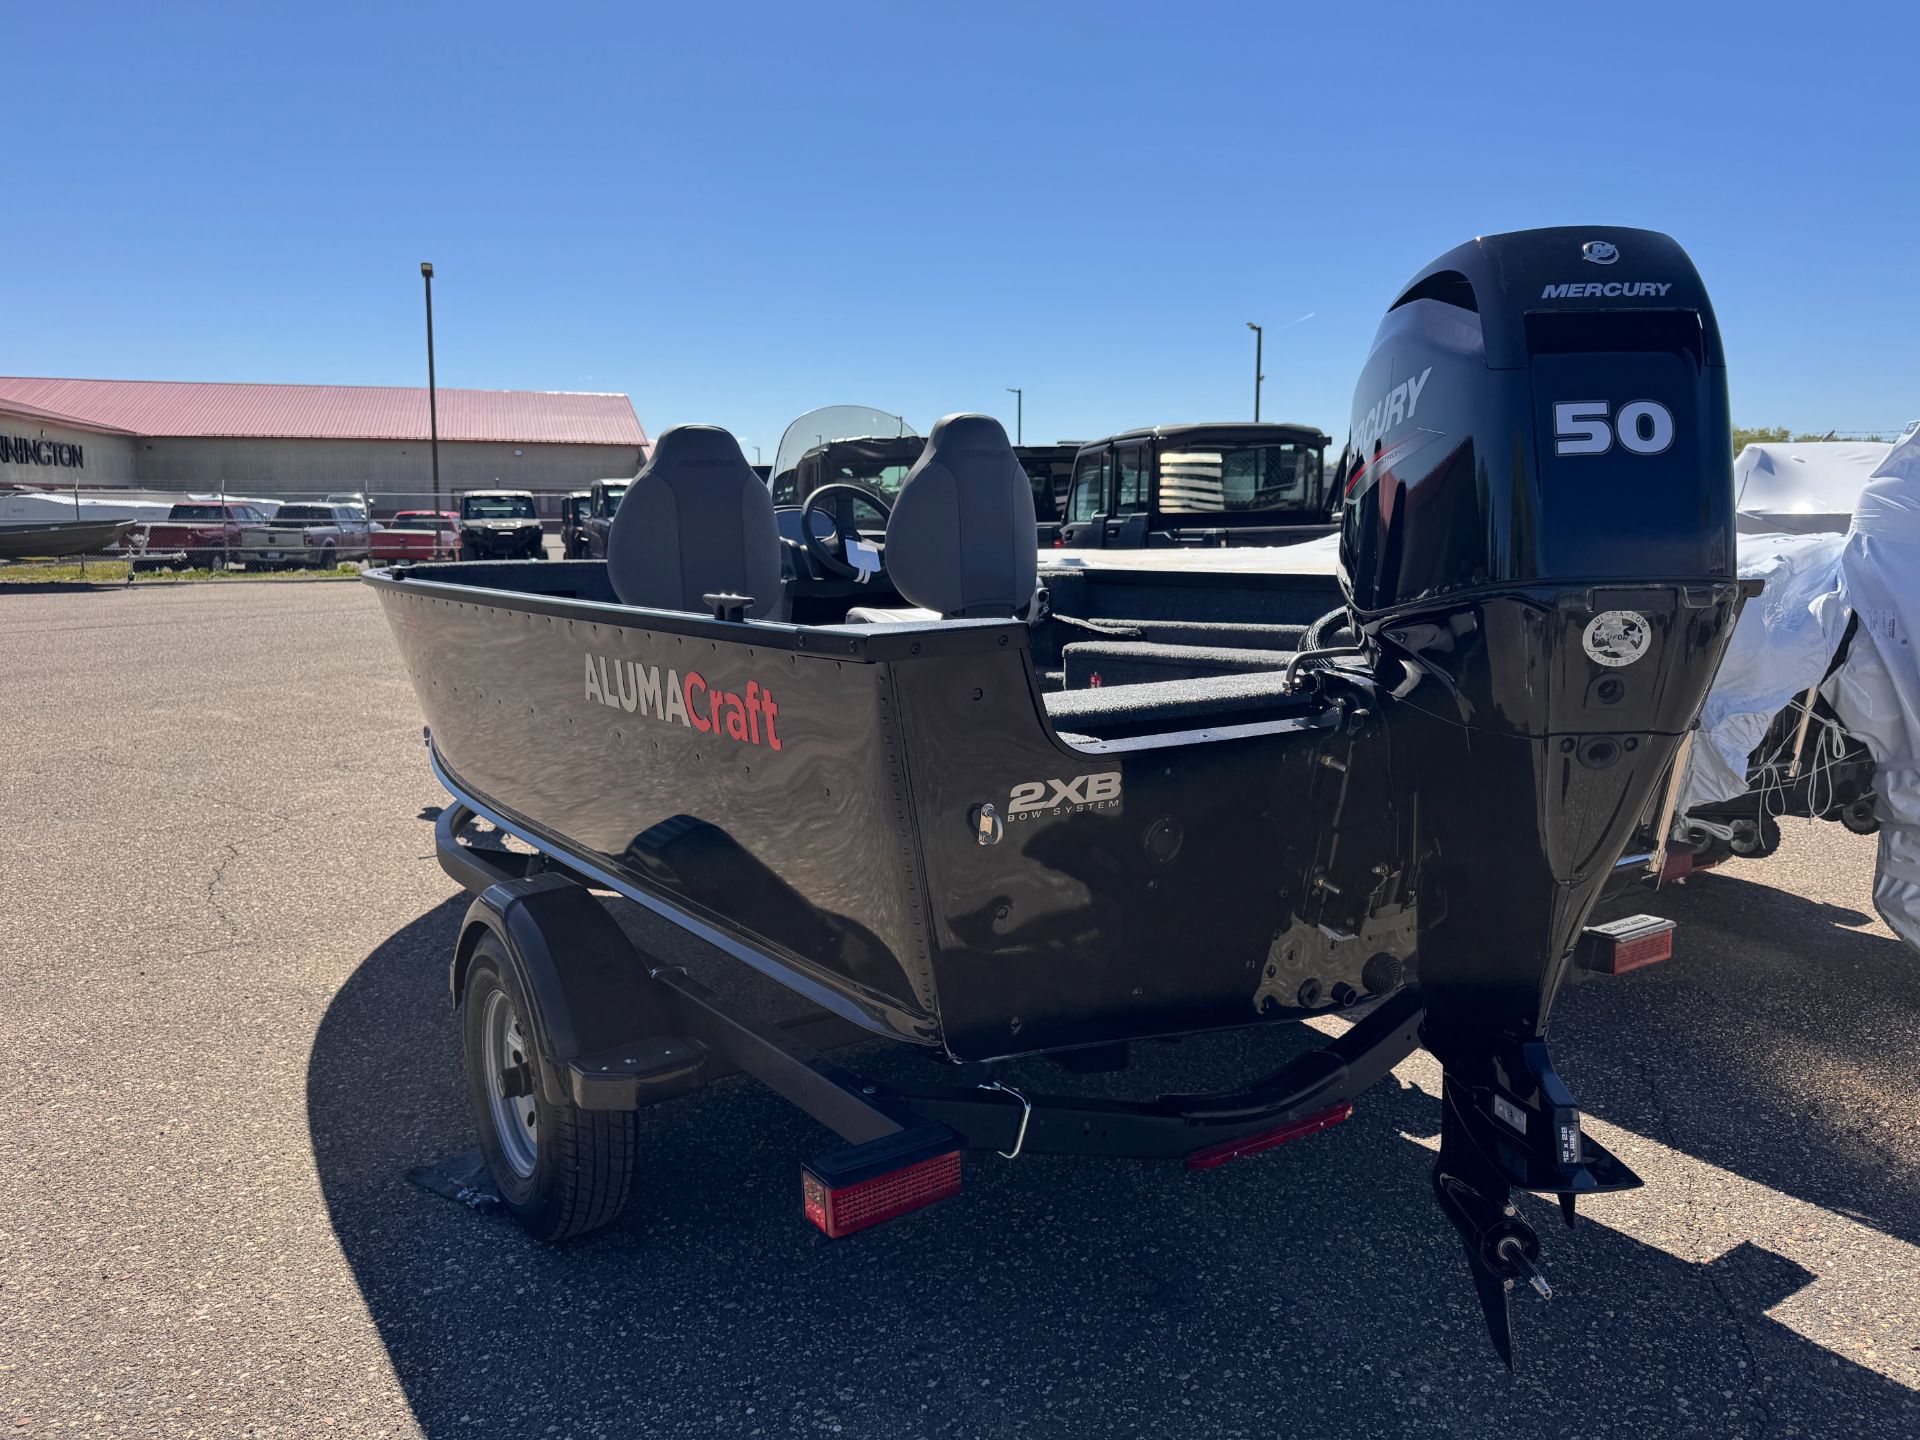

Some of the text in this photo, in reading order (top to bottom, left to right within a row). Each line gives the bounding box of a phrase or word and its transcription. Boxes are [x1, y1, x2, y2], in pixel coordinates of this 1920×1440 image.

[1541, 282, 1673, 299] MERCURY
[1552, 399, 1675, 456] 50
[585, 653, 783, 750] ALUMACraft
[1007, 799, 1120, 823] BOW SYSTEM
[1008, 771, 1122, 814] 2XB
